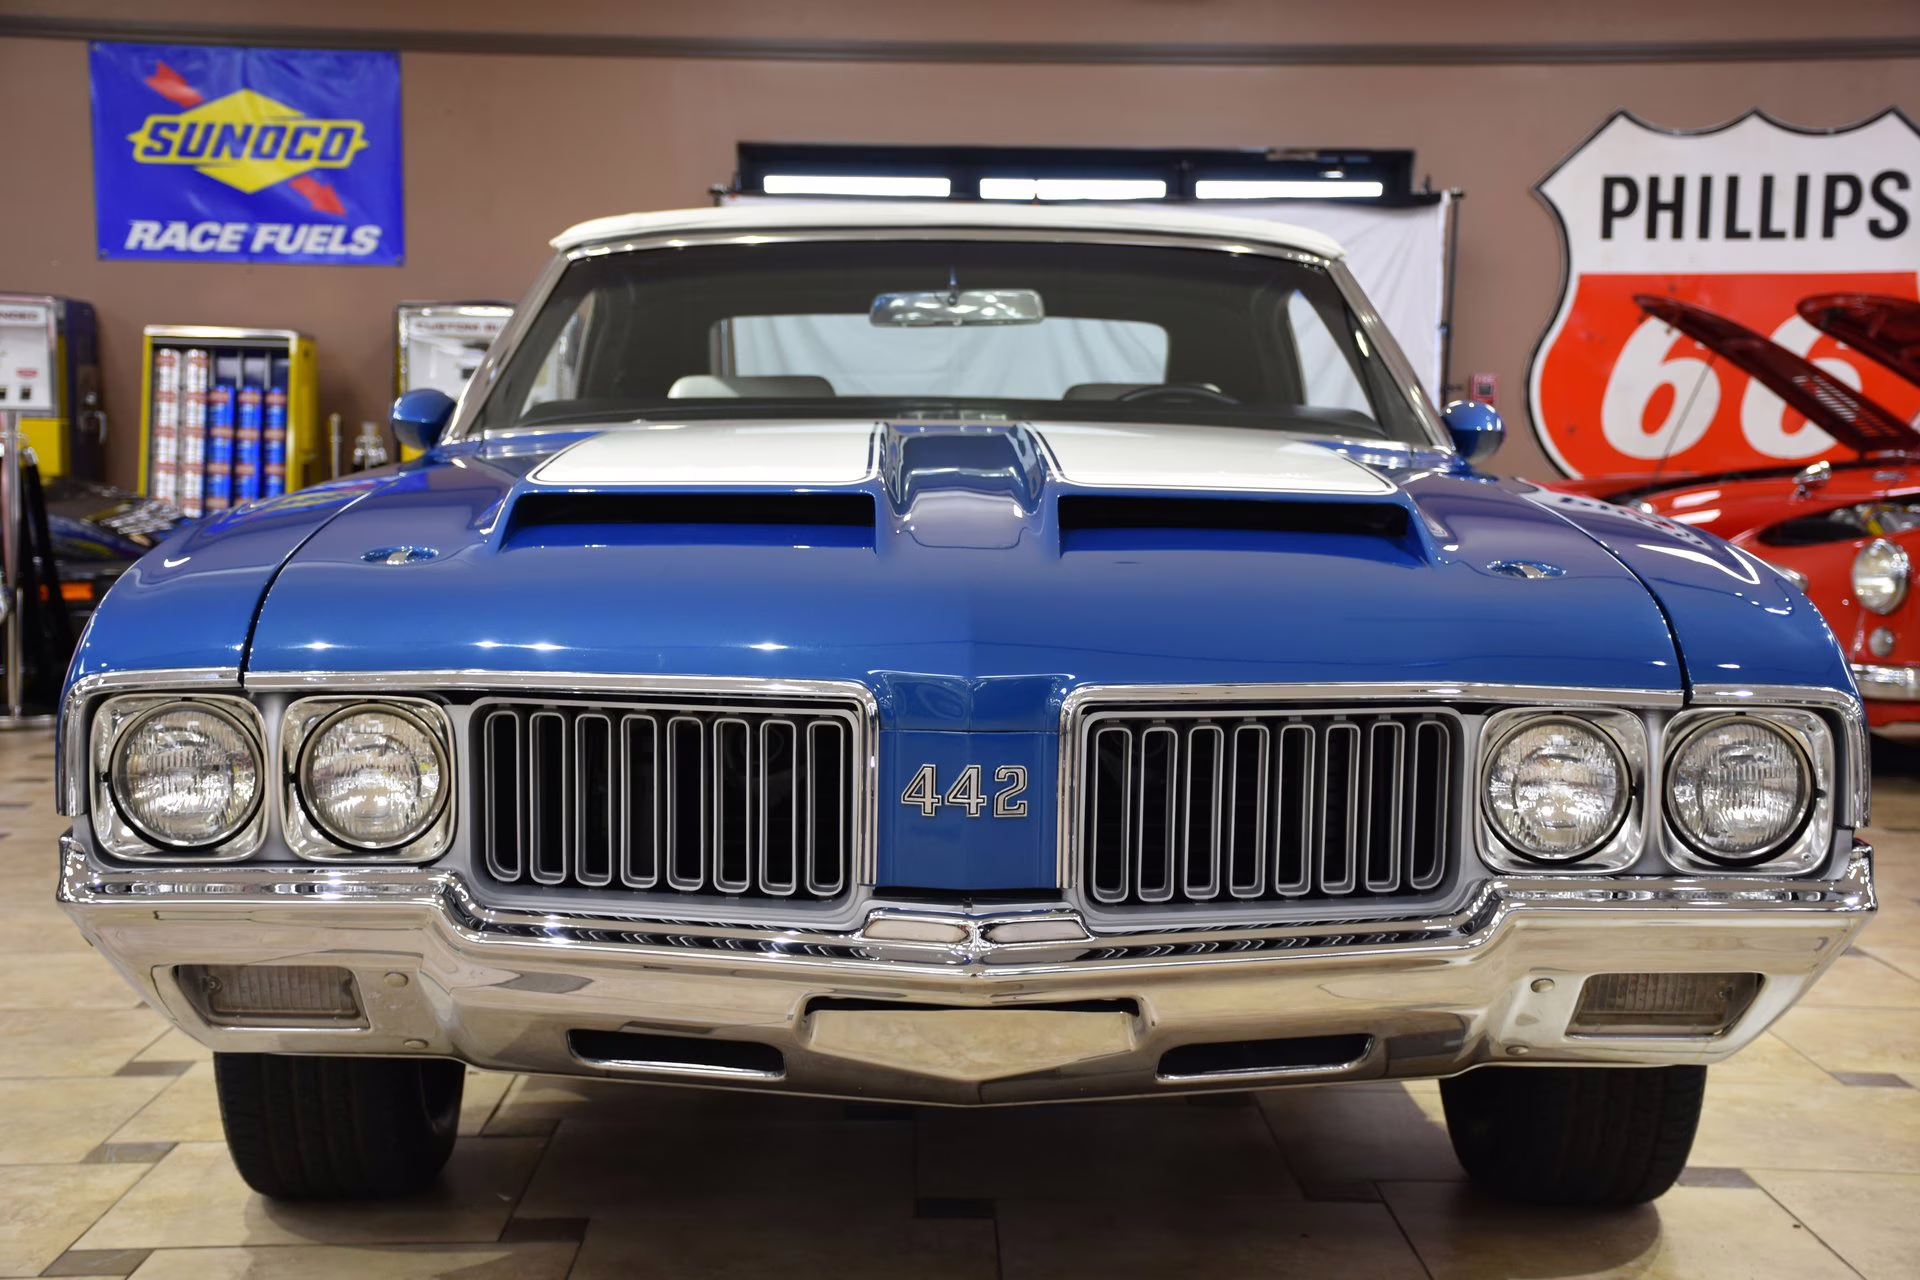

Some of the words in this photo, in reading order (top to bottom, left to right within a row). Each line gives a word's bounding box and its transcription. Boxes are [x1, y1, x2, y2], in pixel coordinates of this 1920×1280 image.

[141, 121, 355, 162] SUNOCO
[1600, 170, 1911, 240] PHILLIPS
[124, 219, 248, 252] RACE
[250, 222, 383, 256] FUELS
[900, 763, 1029, 818] 442
